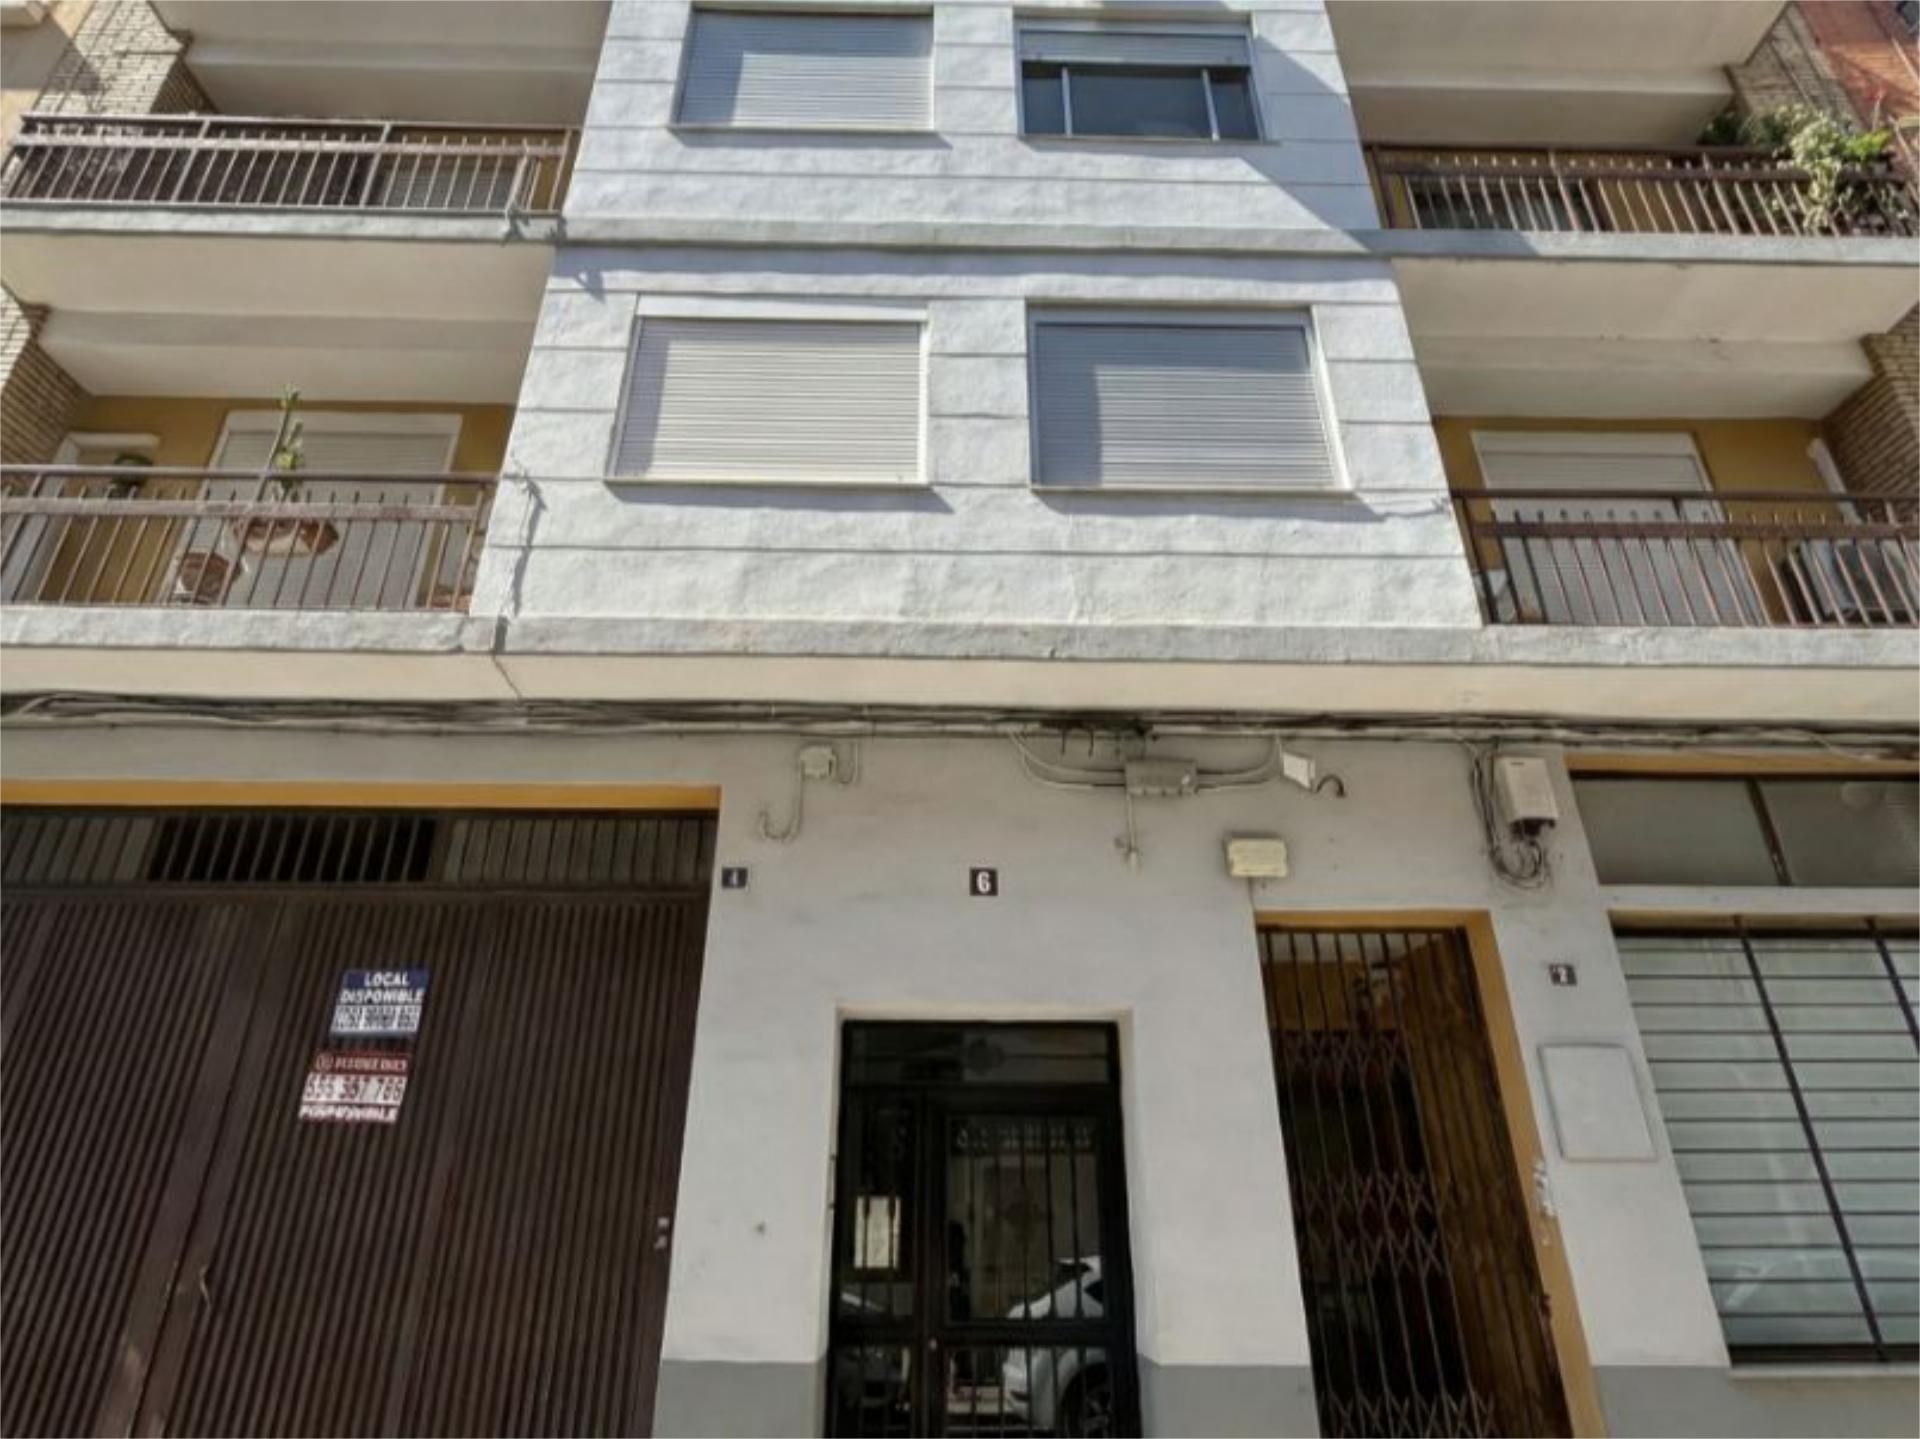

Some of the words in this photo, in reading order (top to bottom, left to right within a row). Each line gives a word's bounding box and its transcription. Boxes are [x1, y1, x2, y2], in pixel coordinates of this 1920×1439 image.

[976, 870, 991, 893] 6
[364, 971, 409, 987] LOCAL
[339, 988, 424, 1004] DISPONIBLE
